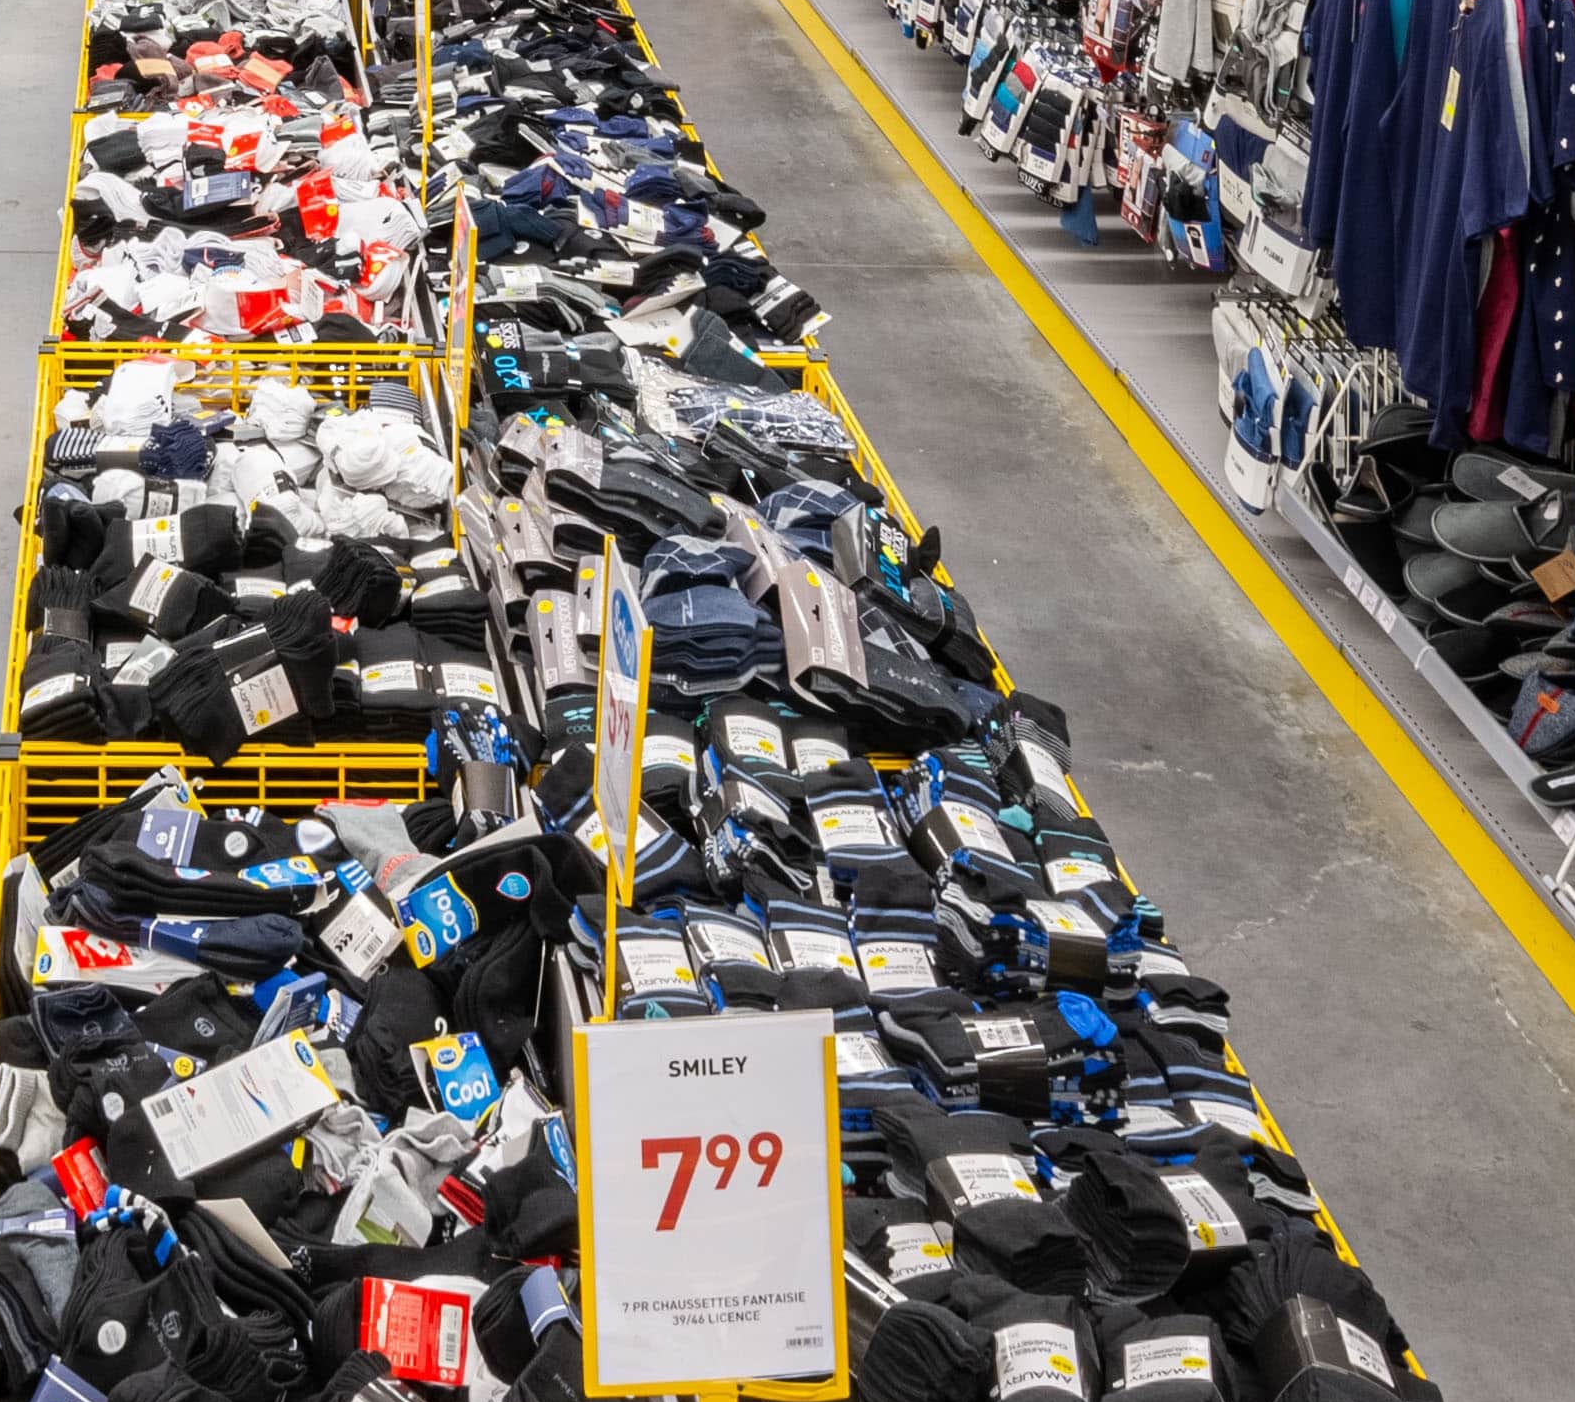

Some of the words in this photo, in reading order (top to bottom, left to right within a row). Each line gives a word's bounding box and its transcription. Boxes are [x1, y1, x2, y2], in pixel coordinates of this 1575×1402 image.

[428, 887, 462, 945] Cool
[668, 1056, 748, 1078] SMILEY
[435, 1072, 480, 1107] Cool
[621, 1302, 628, 1311] 7
[631, 1300, 649, 1311] PR
[653, 1296, 738, 1309] CHAUSSETTES
[742, 1290, 806, 1304] FANTAISIE
[672, 1313, 705, 1326] 39/46
[708, 1310, 760, 1323] LICENCE
